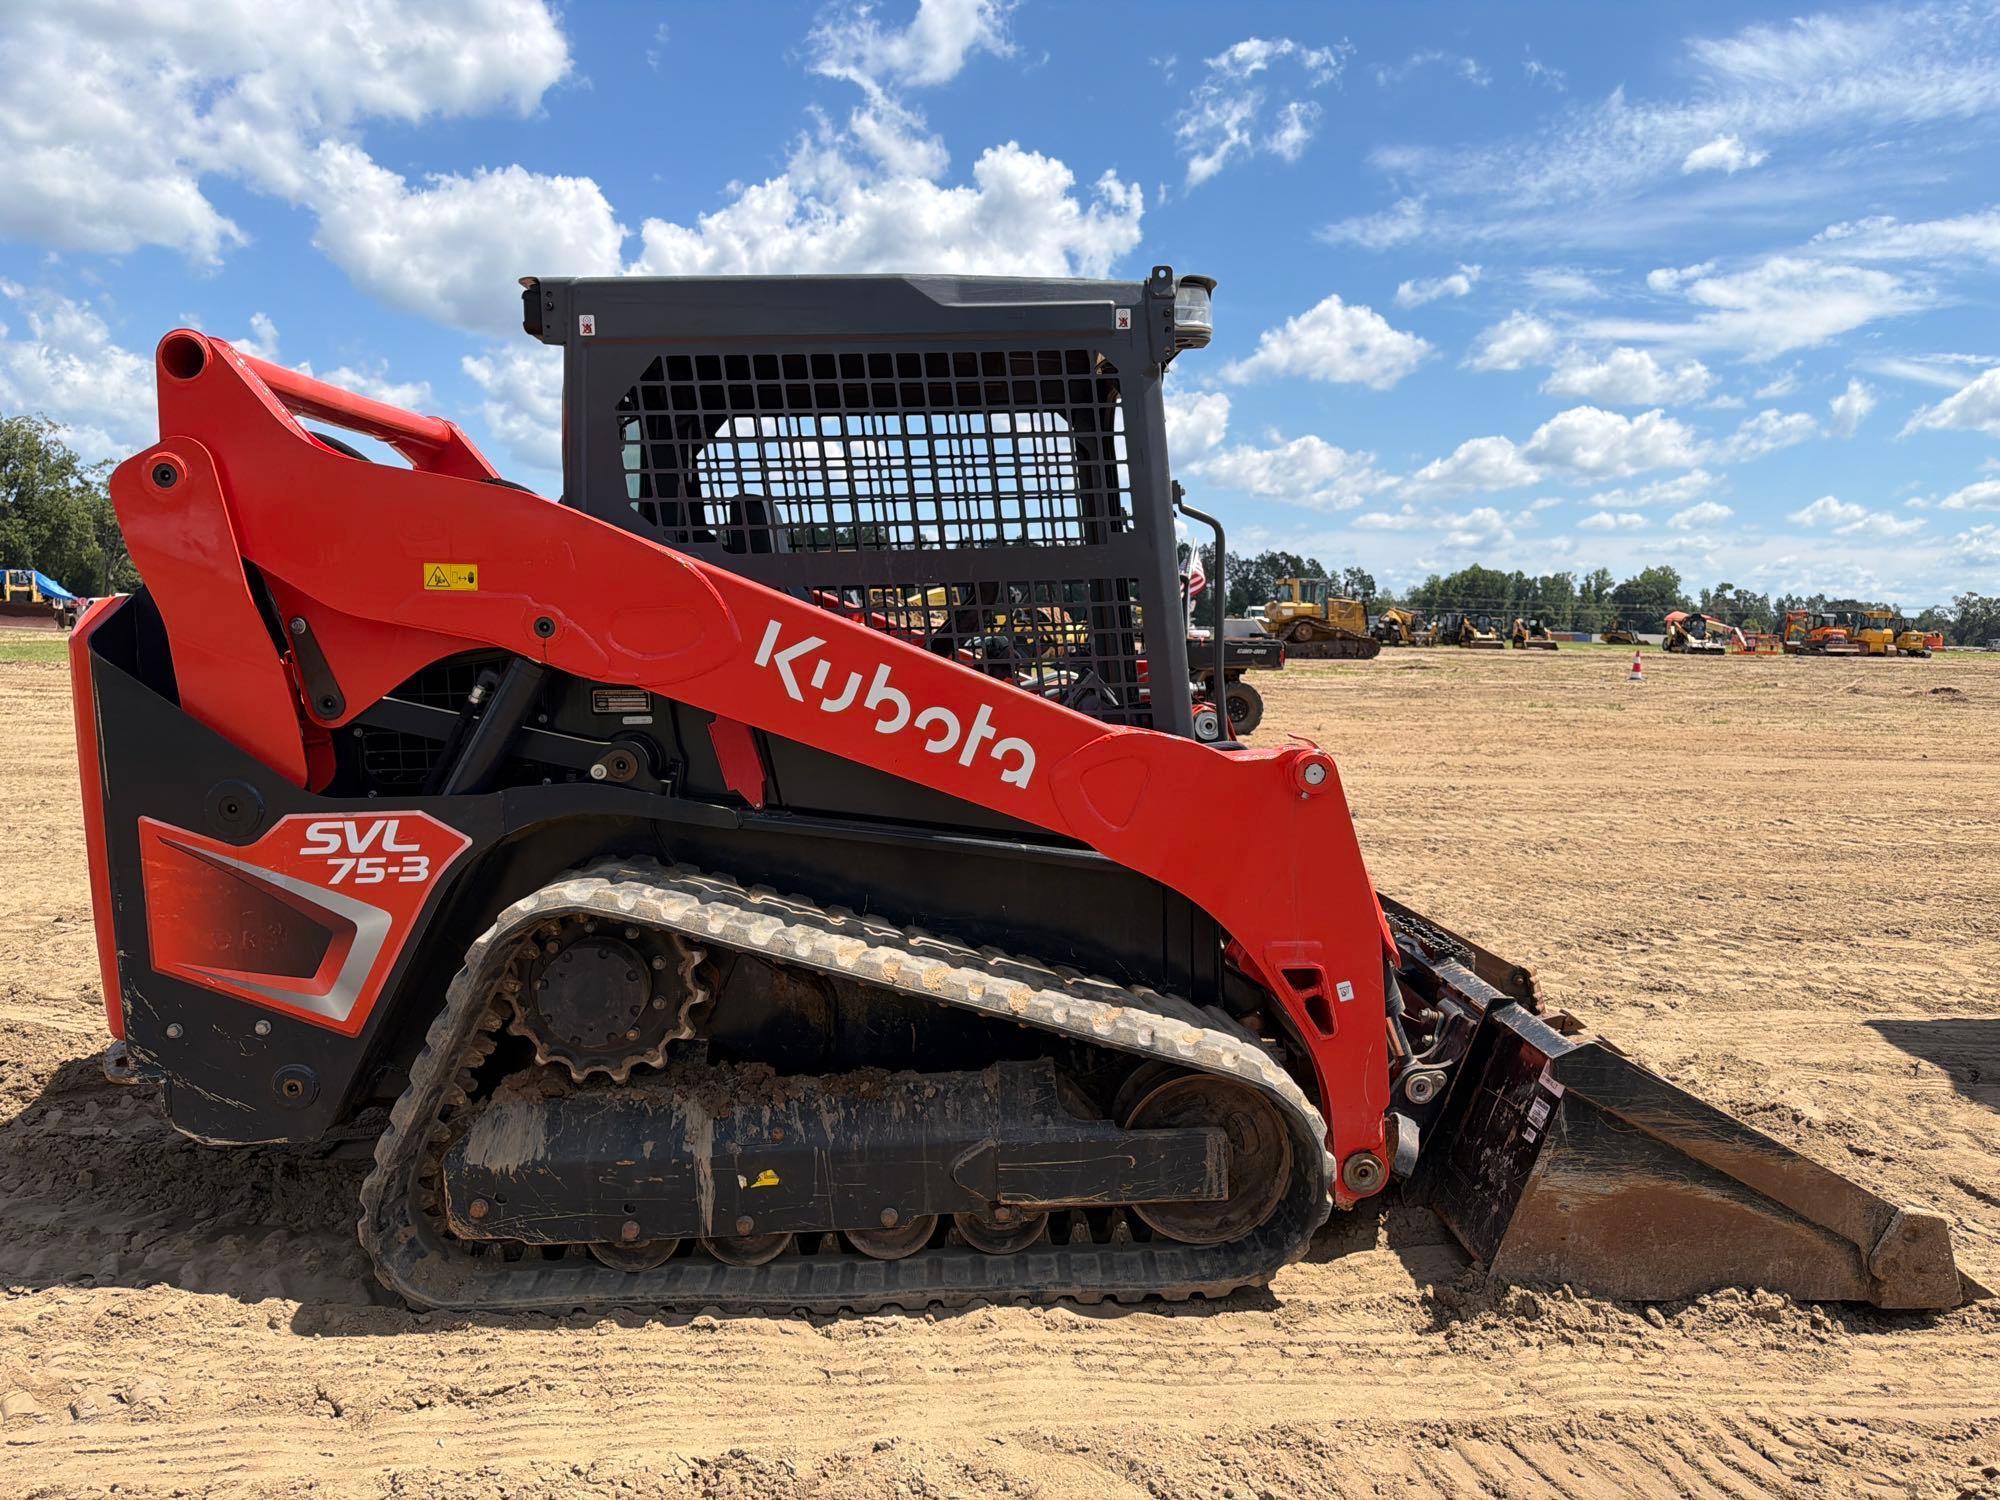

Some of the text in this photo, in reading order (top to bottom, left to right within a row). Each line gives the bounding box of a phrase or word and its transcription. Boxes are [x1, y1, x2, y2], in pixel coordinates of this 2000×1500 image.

[754, 619, 1036, 790] Kubota
[300, 819, 421, 855] SVL
[327, 856, 430, 885] 75-3
